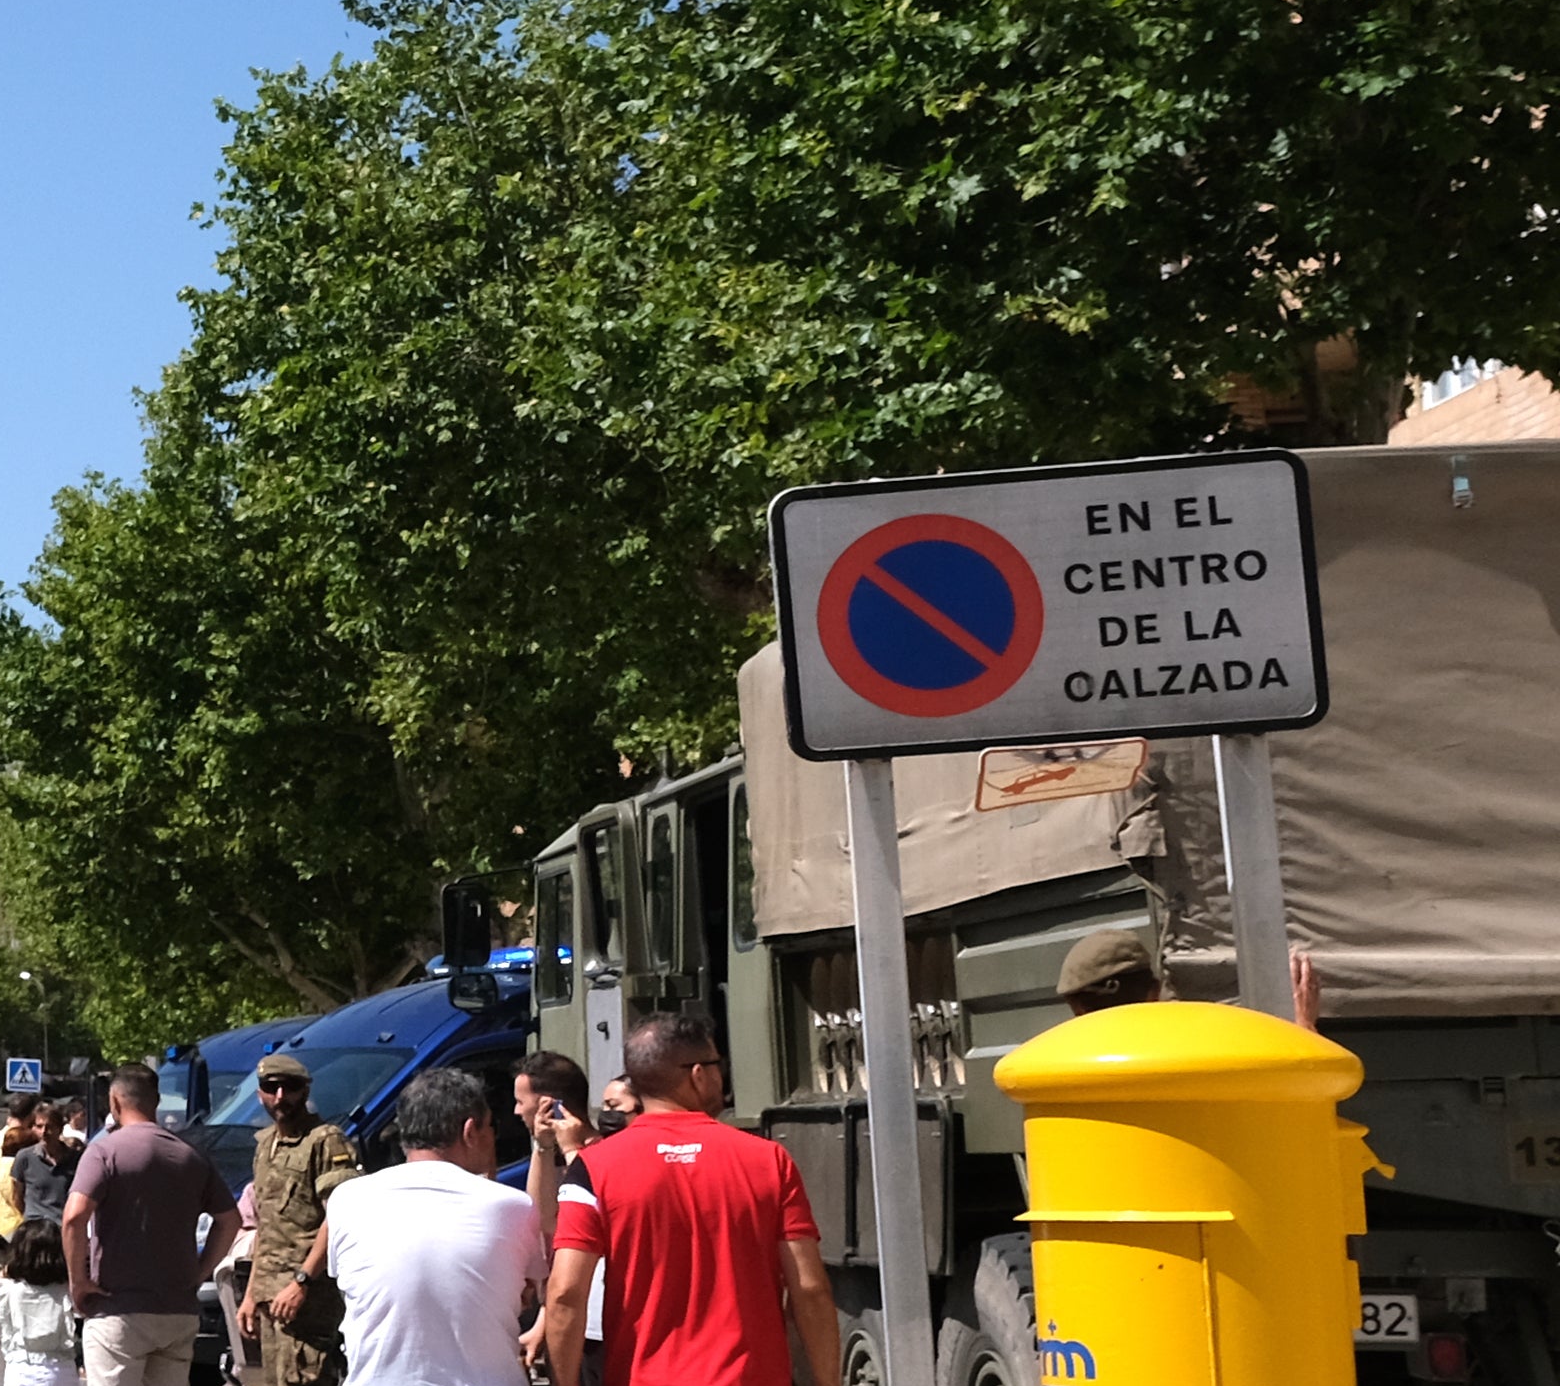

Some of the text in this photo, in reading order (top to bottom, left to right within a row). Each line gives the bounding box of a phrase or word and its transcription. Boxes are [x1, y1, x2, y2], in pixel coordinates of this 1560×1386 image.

[1085, 496, 1232, 535] EN EL
[1063, 549, 1268, 595] CENTRO
[1098, 608, 1242, 648] DE LA
[1063, 658, 1289, 703] CALZADA
